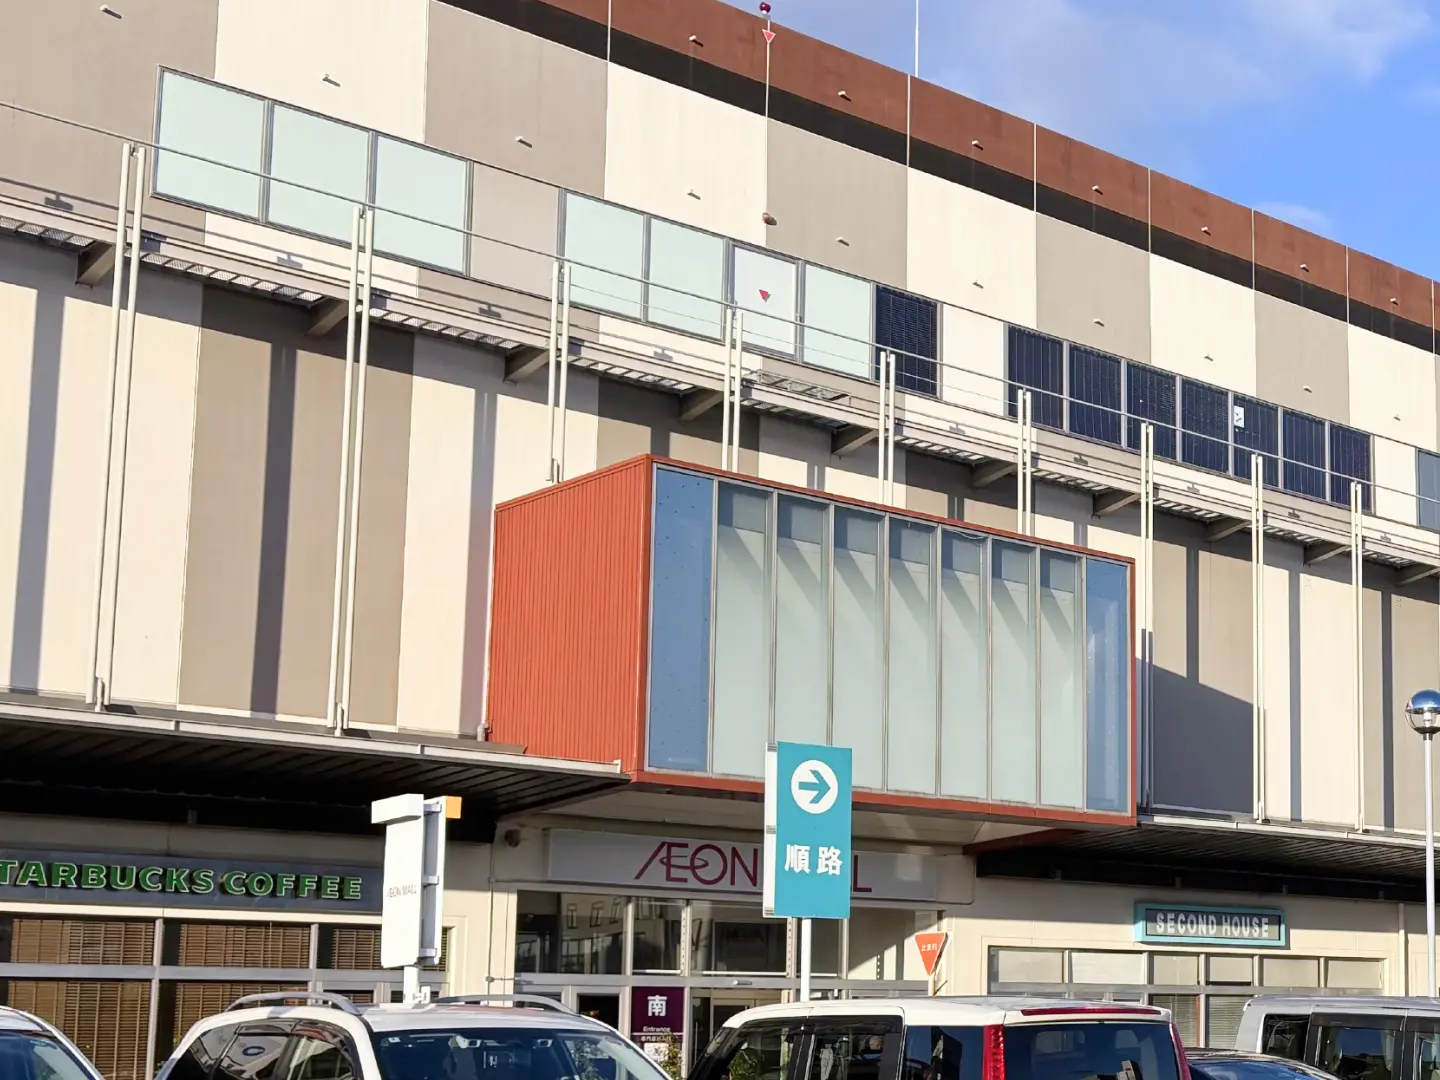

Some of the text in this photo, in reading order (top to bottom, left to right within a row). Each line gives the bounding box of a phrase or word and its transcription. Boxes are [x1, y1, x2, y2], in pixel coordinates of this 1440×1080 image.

[784, 844, 843, 875] 順路
[222, 870, 363, 900] COFFEE
[1155, 912, 1270, 938] SECOND HOUSE
[647, 995, 668, 1017] 南
